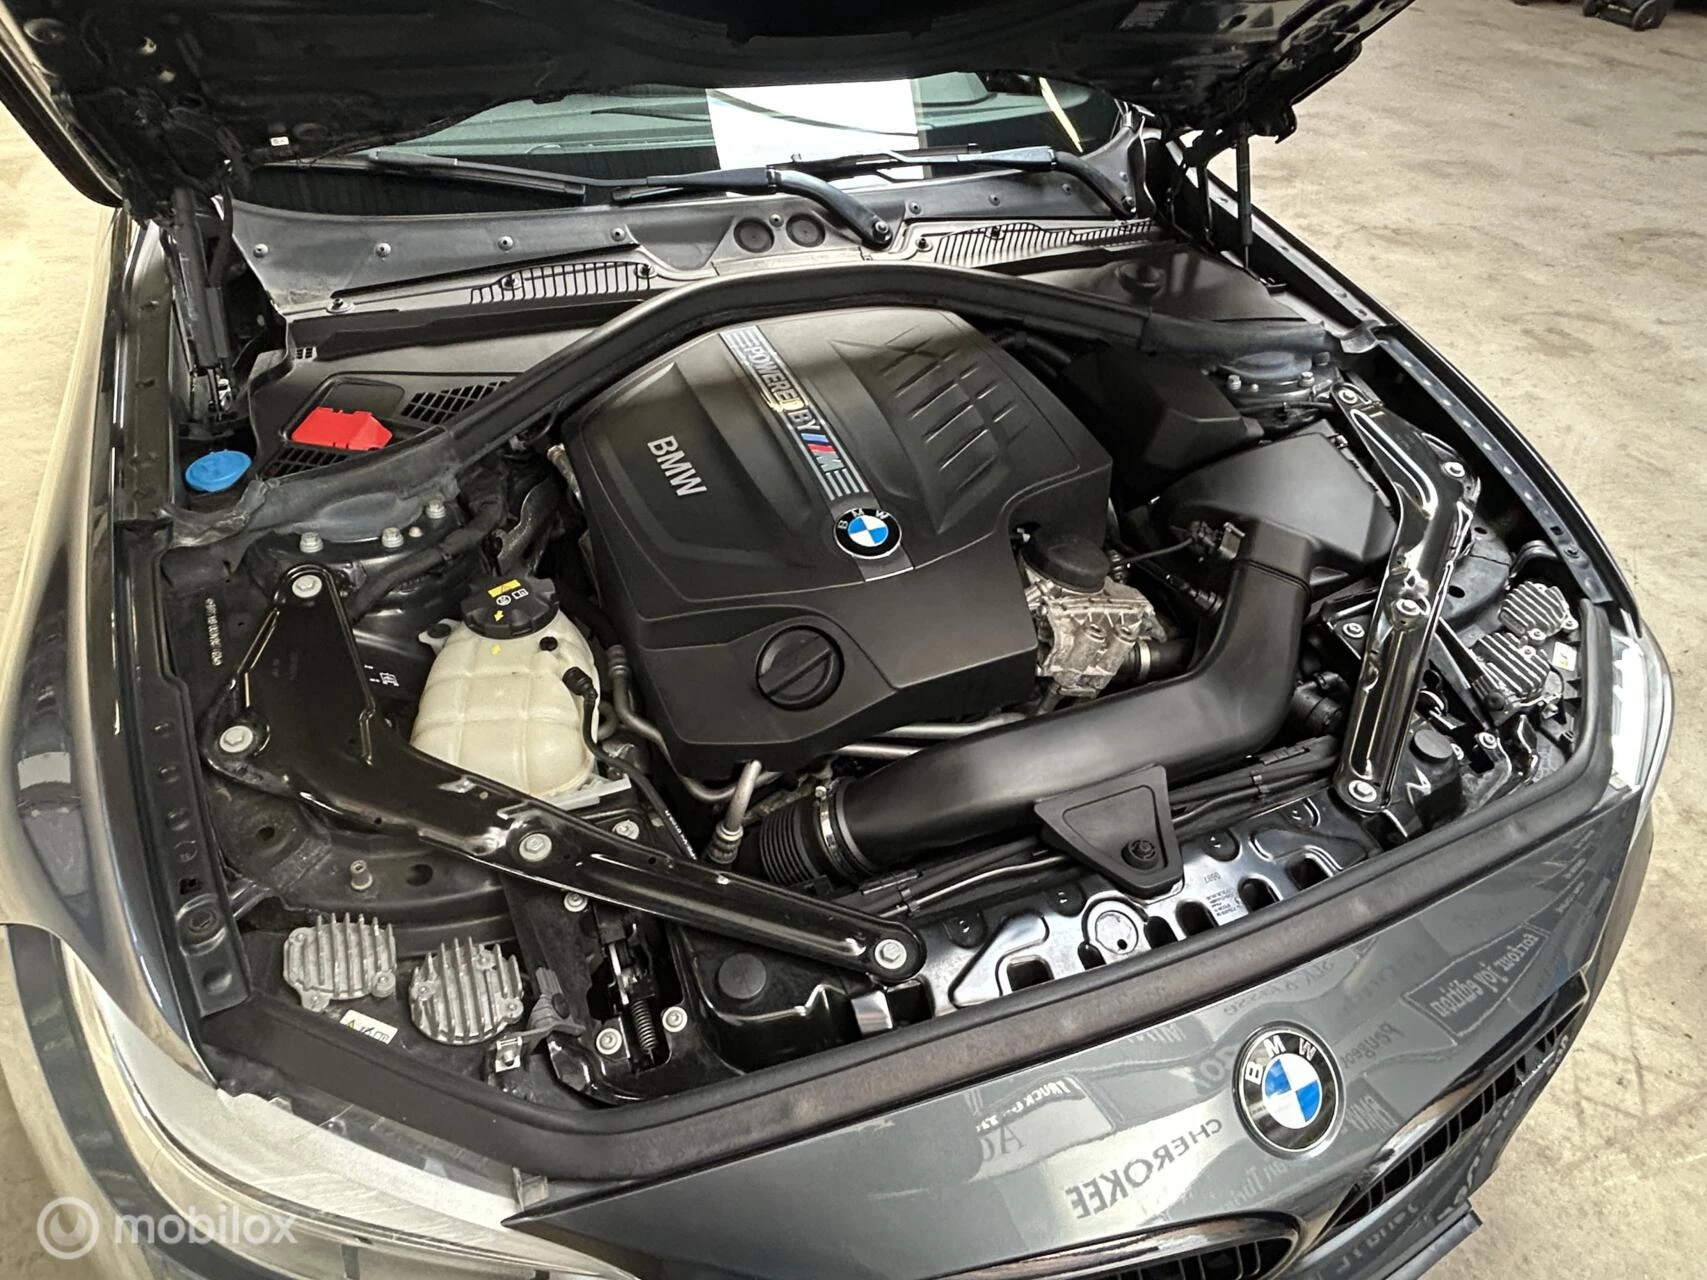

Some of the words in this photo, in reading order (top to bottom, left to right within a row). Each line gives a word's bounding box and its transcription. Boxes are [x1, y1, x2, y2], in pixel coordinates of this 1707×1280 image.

[745, 346, 806, 411] POWERED
[787, 409, 821, 431] BY
[647, 434, 708, 497] BMW
